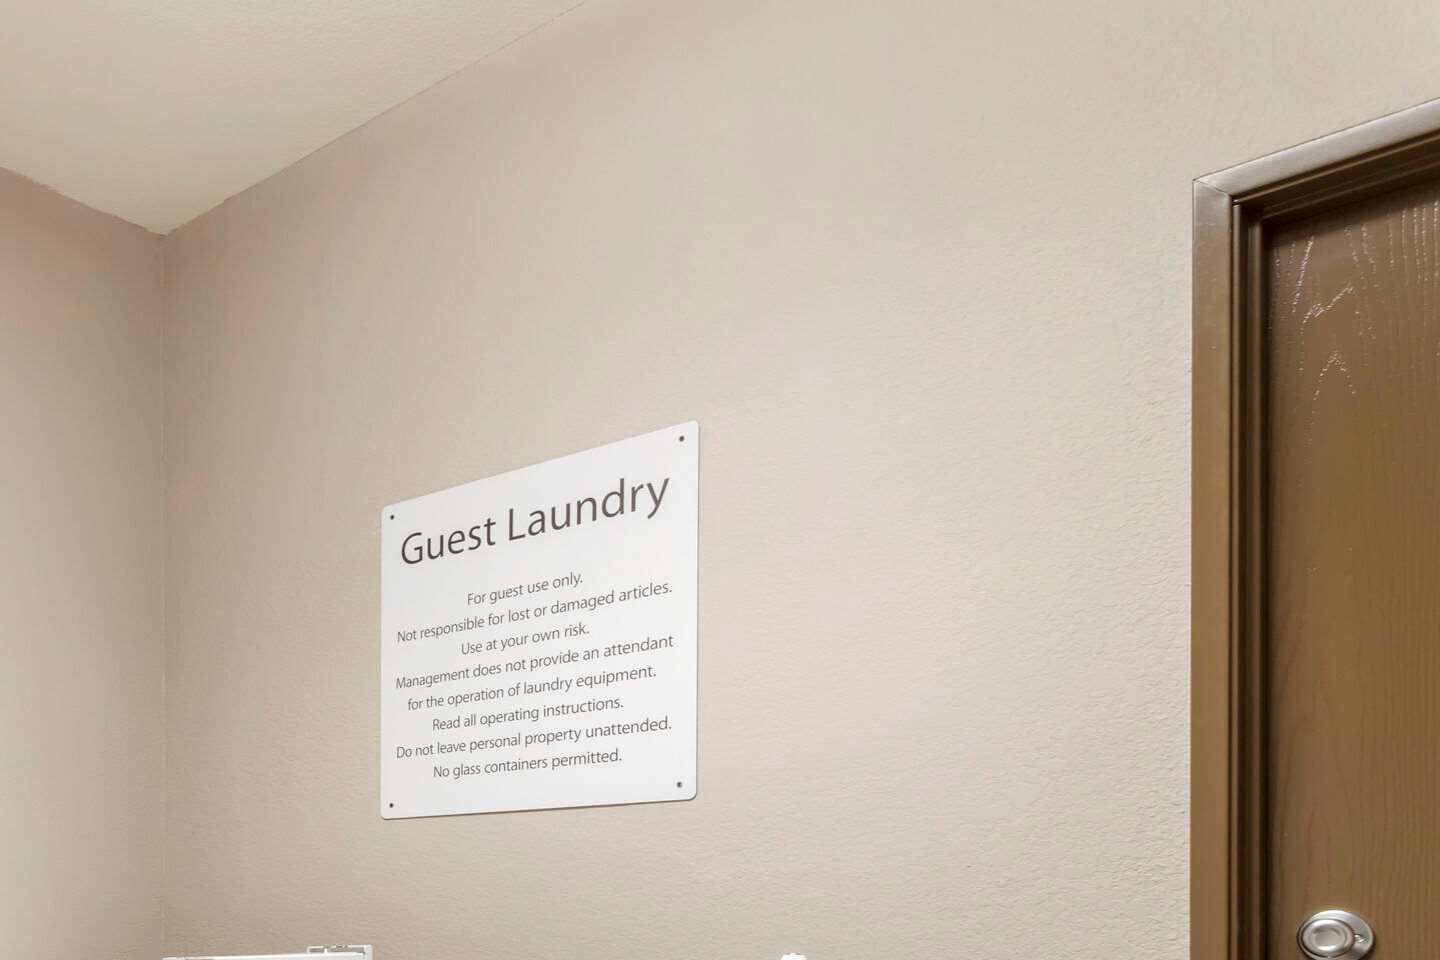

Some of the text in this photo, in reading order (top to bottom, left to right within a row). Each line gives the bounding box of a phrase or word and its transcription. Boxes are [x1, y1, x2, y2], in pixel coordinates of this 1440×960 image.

[401, 478, 670, 565] Guest Laundry
[467, 571, 583, 606] For guest use only.
[397, 582, 672, 643] Not responsible for lost or damaged articles.
[461, 622, 590, 656] Use at your own risk.
[396, 636, 674, 689] Management does not provide an attendant
[408, 666, 656, 711] for the operation of laundry equipment.
[432, 698, 624, 731] Read all operating instructions.
[396, 715, 672, 759] Do not leave personal property unattended.
[433, 747, 622, 780] No glass containers permitted.
